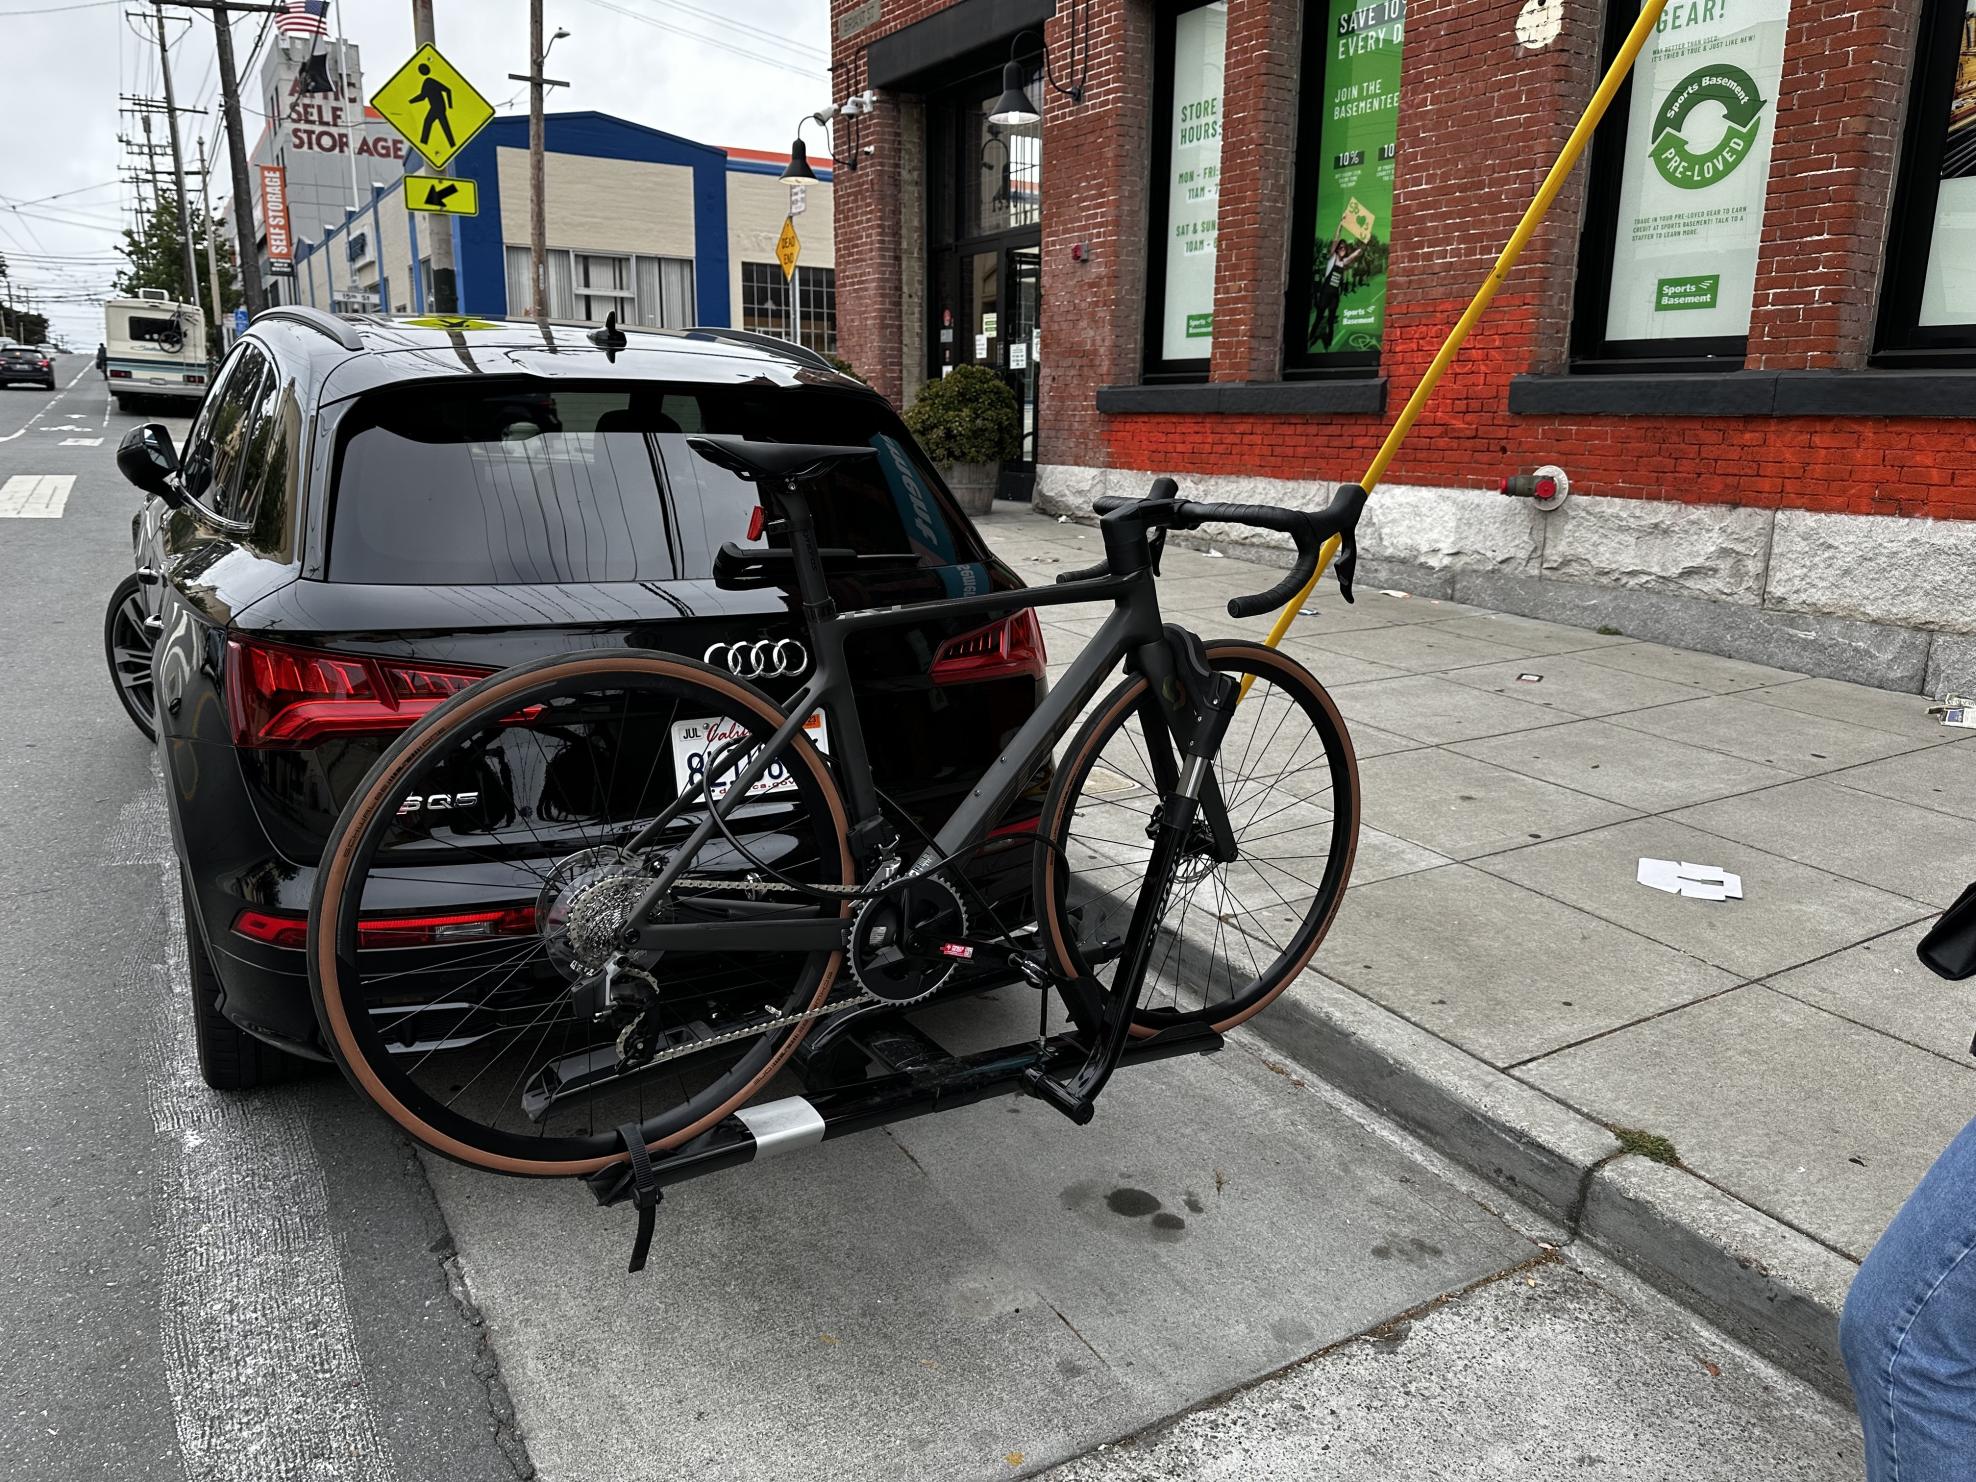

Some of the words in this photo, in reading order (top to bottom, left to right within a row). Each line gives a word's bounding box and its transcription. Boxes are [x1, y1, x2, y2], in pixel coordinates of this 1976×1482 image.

[1340, 5, 1376, 33] SAVE
[1656, 0, 1726, 33] GEAR!
[1338, 27, 1386, 59] EVERY
[1663, 51, 1679, 61] TRIED
[1687, 46, 1701, 56] TRUE
[1709, 41, 1723, 51] JUST
[1725, 38, 1738, 47] LIKE
[1335, 84, 1359, 103] JOIN
[1363, 79, 1382, 97] THE
[1666, 82, 1699, 119] Sports
[1701, 76, 1750, 105] Basement
[290, 102, 343, 127] SELF
[1181, 97, 1217, 122] STORE
[1180, 120, 1222, 145] HOURS:
[291, 127, 405, 159] STORAGE
[1339, 150, 1360, 167] 10%
[1661, 137, 1744, 181] PRE-LOVED
[1178, 170, 1195, 185] MON
[264, 169, 285, 226] STORAGE
[1188, 186, 1205, 200] 11AM
[1674, 210, 1705, 221] PRE-LOVED
[1706, 208, 1721, 217] GEAR
[1732, 205, 1747, 214] EARN
[1176, 223, 1190, 238] SAT
[1661, 221, 1681, 230] SPORTS
[1716, 215, 1729, 224] TALK
[270, 226, 288, 254] SELF
[1656, 231, 1662, 239] TO
[1664, 229, 1681, 239] LEARN
[781, 236, 795, 250] DEAD
[1186, 239, 1205, 253] 10AM
[783, 252, 794, 265] END
[1662, 283, 1696, 296] Sports
[1660, 293, 1712, 305] Basement
[1342, 316, 1375, 325] Basement
[1343, 308, 1365, 317] Sports
[683, 728, 702, 740] JUL
[399, 791, 479, 813] SQ5
